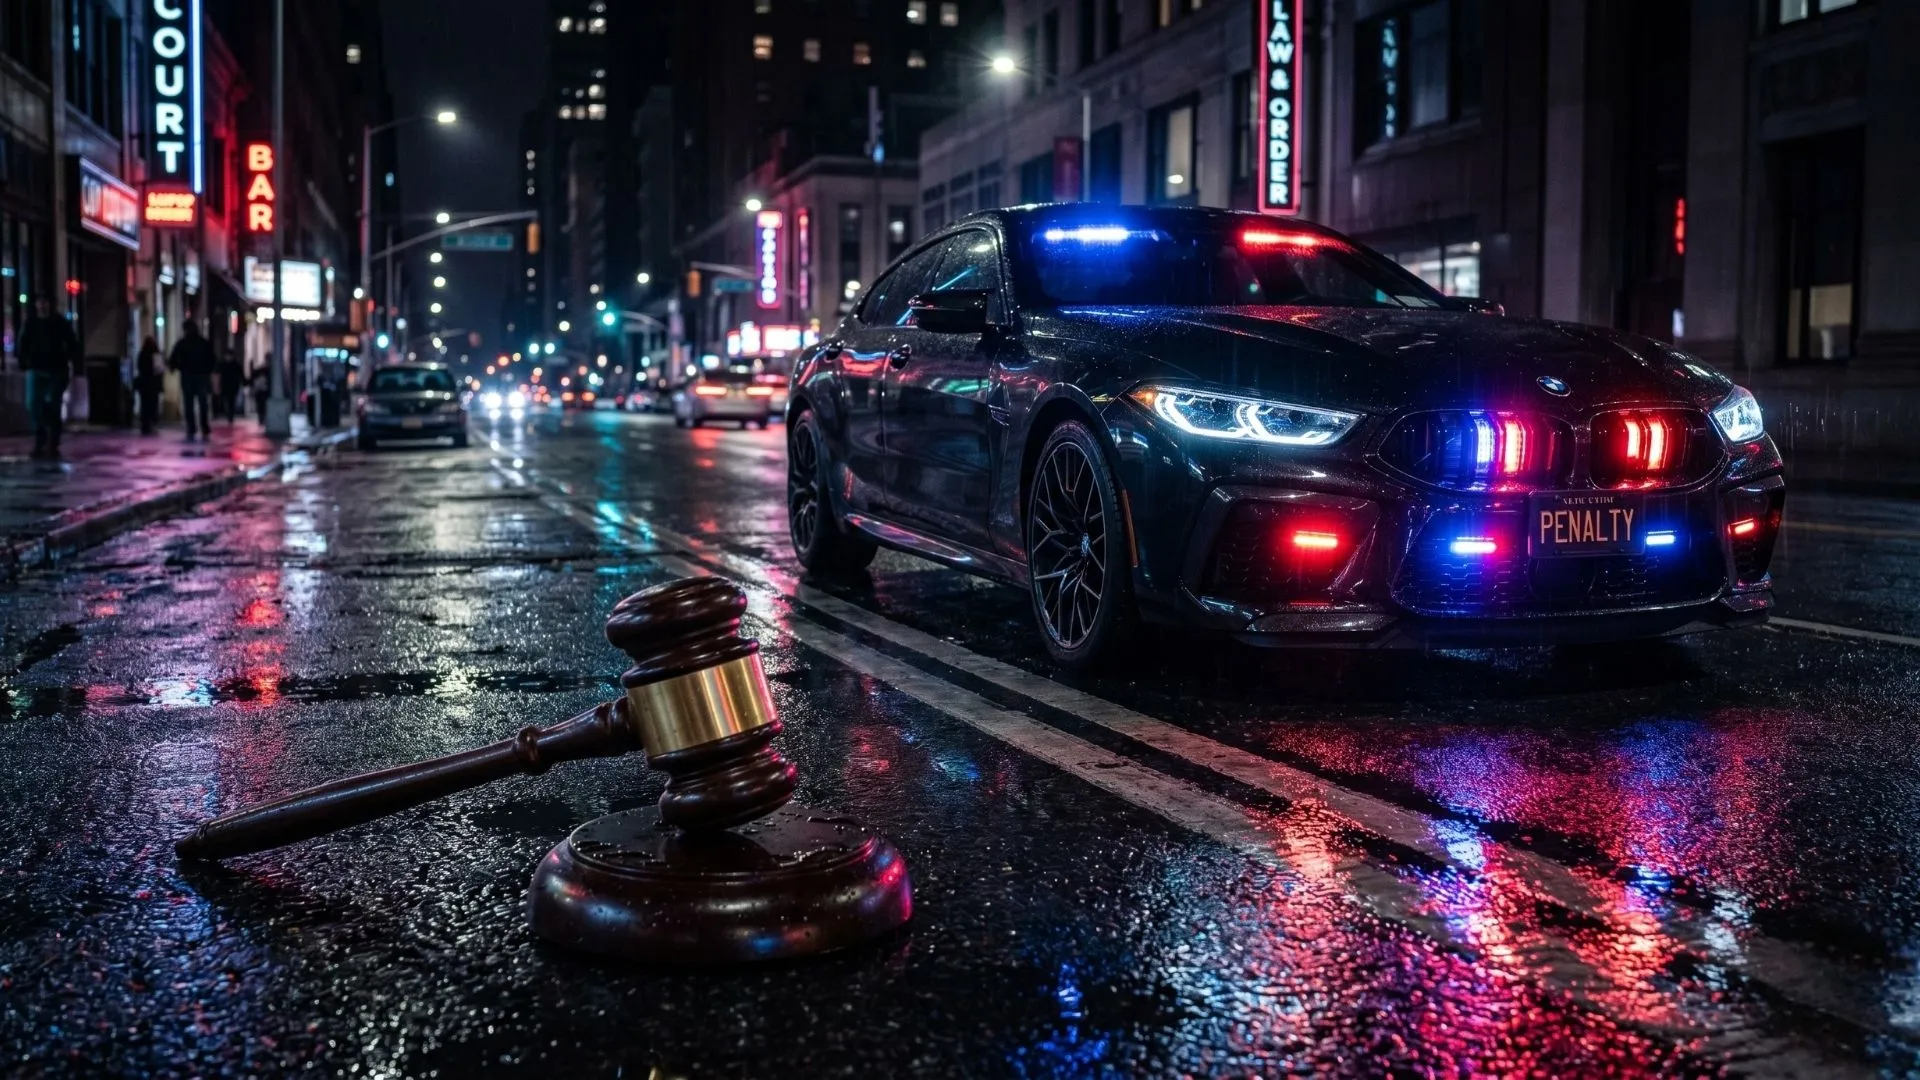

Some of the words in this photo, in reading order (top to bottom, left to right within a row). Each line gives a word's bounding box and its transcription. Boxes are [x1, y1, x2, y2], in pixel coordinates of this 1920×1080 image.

[1267, 0, 1294, 64] LAW
[153, 0, 185, 173] COURT
[1270, 68, 1290, 90] &
[248, 144, 275, 231] BAR
[1269, 97, 1291, 204] ORDER
[1540, 509, 1634, 544] PENALTY
